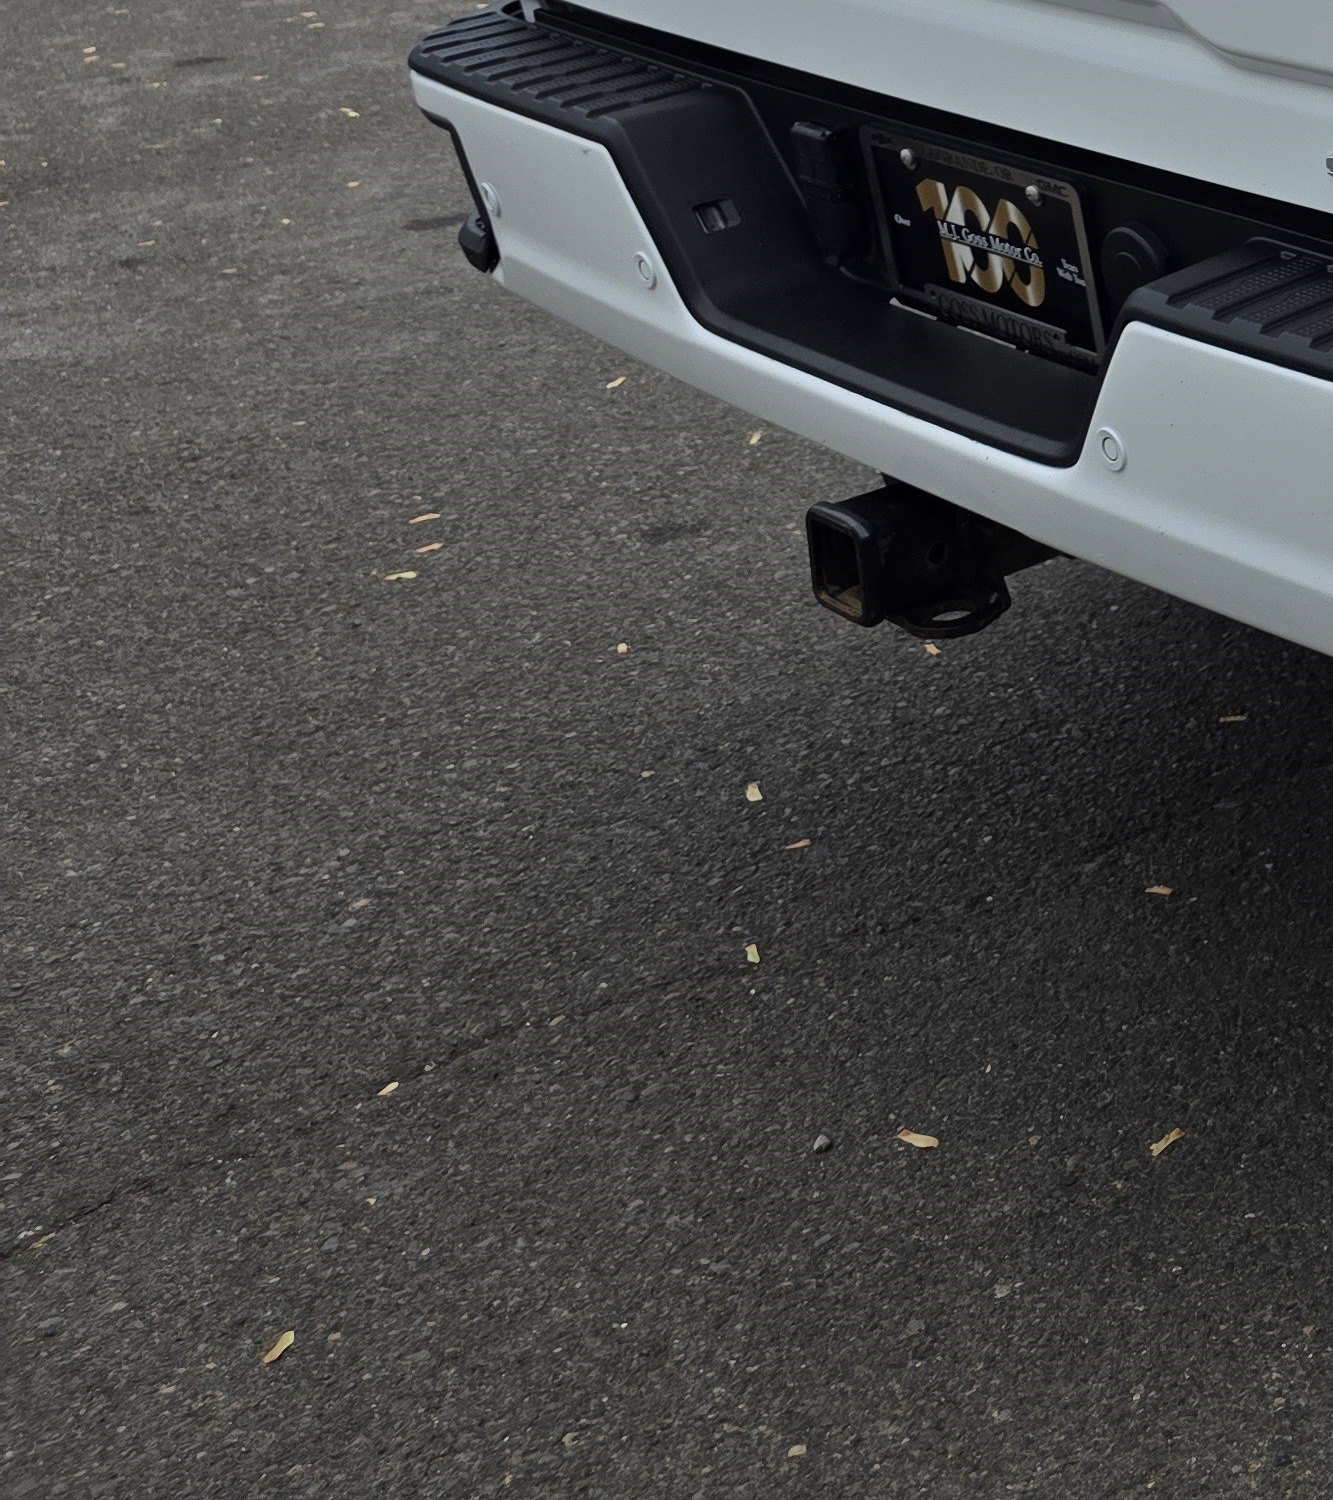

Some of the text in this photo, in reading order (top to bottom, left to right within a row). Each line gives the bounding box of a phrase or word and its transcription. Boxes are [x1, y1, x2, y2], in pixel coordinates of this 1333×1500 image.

[915, 177, 1046, 308] 100
[961, 227, 988, 248] Goss
[989, 234, 1023, 259] Motor
